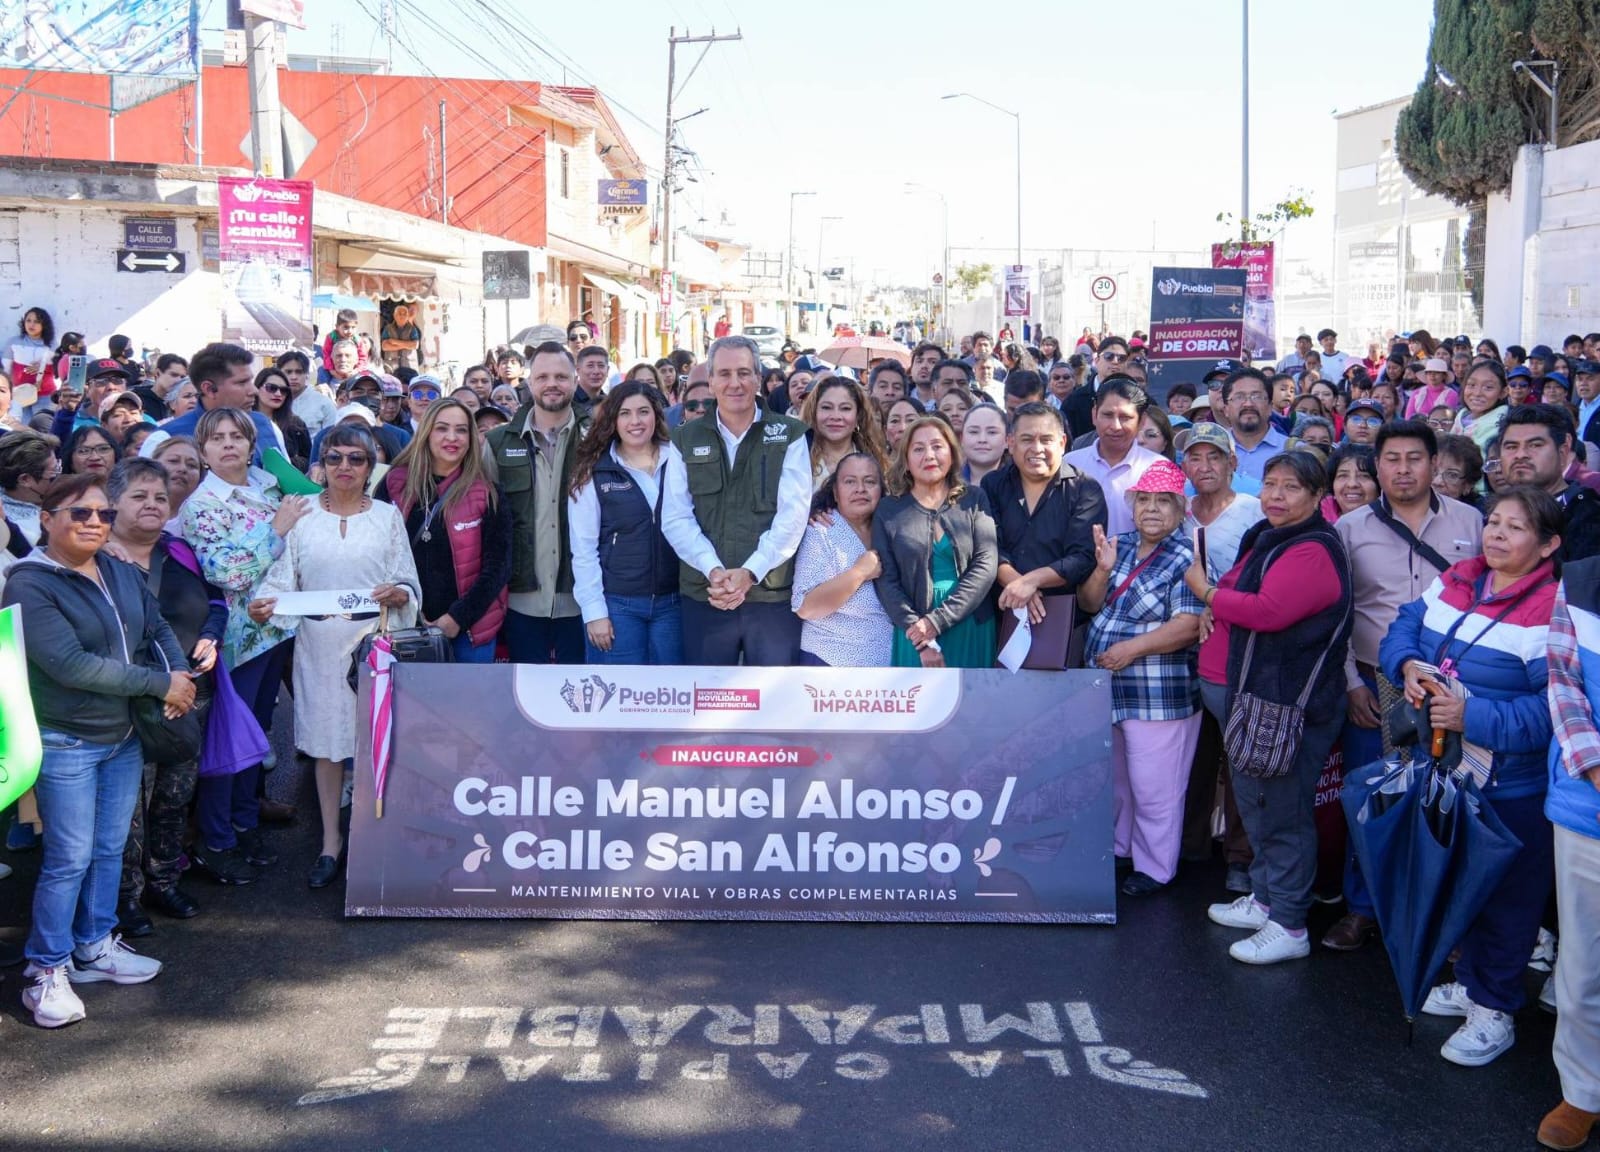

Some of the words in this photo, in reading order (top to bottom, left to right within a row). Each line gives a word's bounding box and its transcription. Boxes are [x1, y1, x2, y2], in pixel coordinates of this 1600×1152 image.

[603, 206, 642, 214] JIMMY
[259, 211, 297, 225] calle
[138, 226, 163, 234] CALLE
[129, 235, 145, 243] SAN
[147, 236, 173, 244] ISIDRO
[1097, 281, 1111, 289] 30
[1182, 284, 1213, 293] Puebla
[1155, 328, 1238, 340] INAUGURACIÓN
[1162, 341, 1182, 353] DE
[1185, 340, 1230, 352] OBRA
[619, 687, 691, 705] Puebla
[820, 690, 832, 698] LA
[844, 690, 906, 699] CAPITAL
[813, 700, 915, 713] IMPARABLE
[671, 748, 799, 764] INAUGURACIÓN
[453, 776, 584, 817] Calle
[596, 777, 785, 819] Manuel
[797, 779, 984, 820] Alonso
[991, 776, 1017, 826] /
[502, 829, 634, 871] Calle
[644, 832, 743, 872] San
[753, 832, 962, 873] Alfonso
[511, 885, 655, 899] MANTENIMIENTO
[662, 887, 700, 899] VIAL
[707, 888, 717, 899] Y
[724, 888, 781, 899] OBRAS
[788, 888, 958, 900] COMPLEMENTARIAS
[372, 1002, 1103, 1049] IMPARABLE
